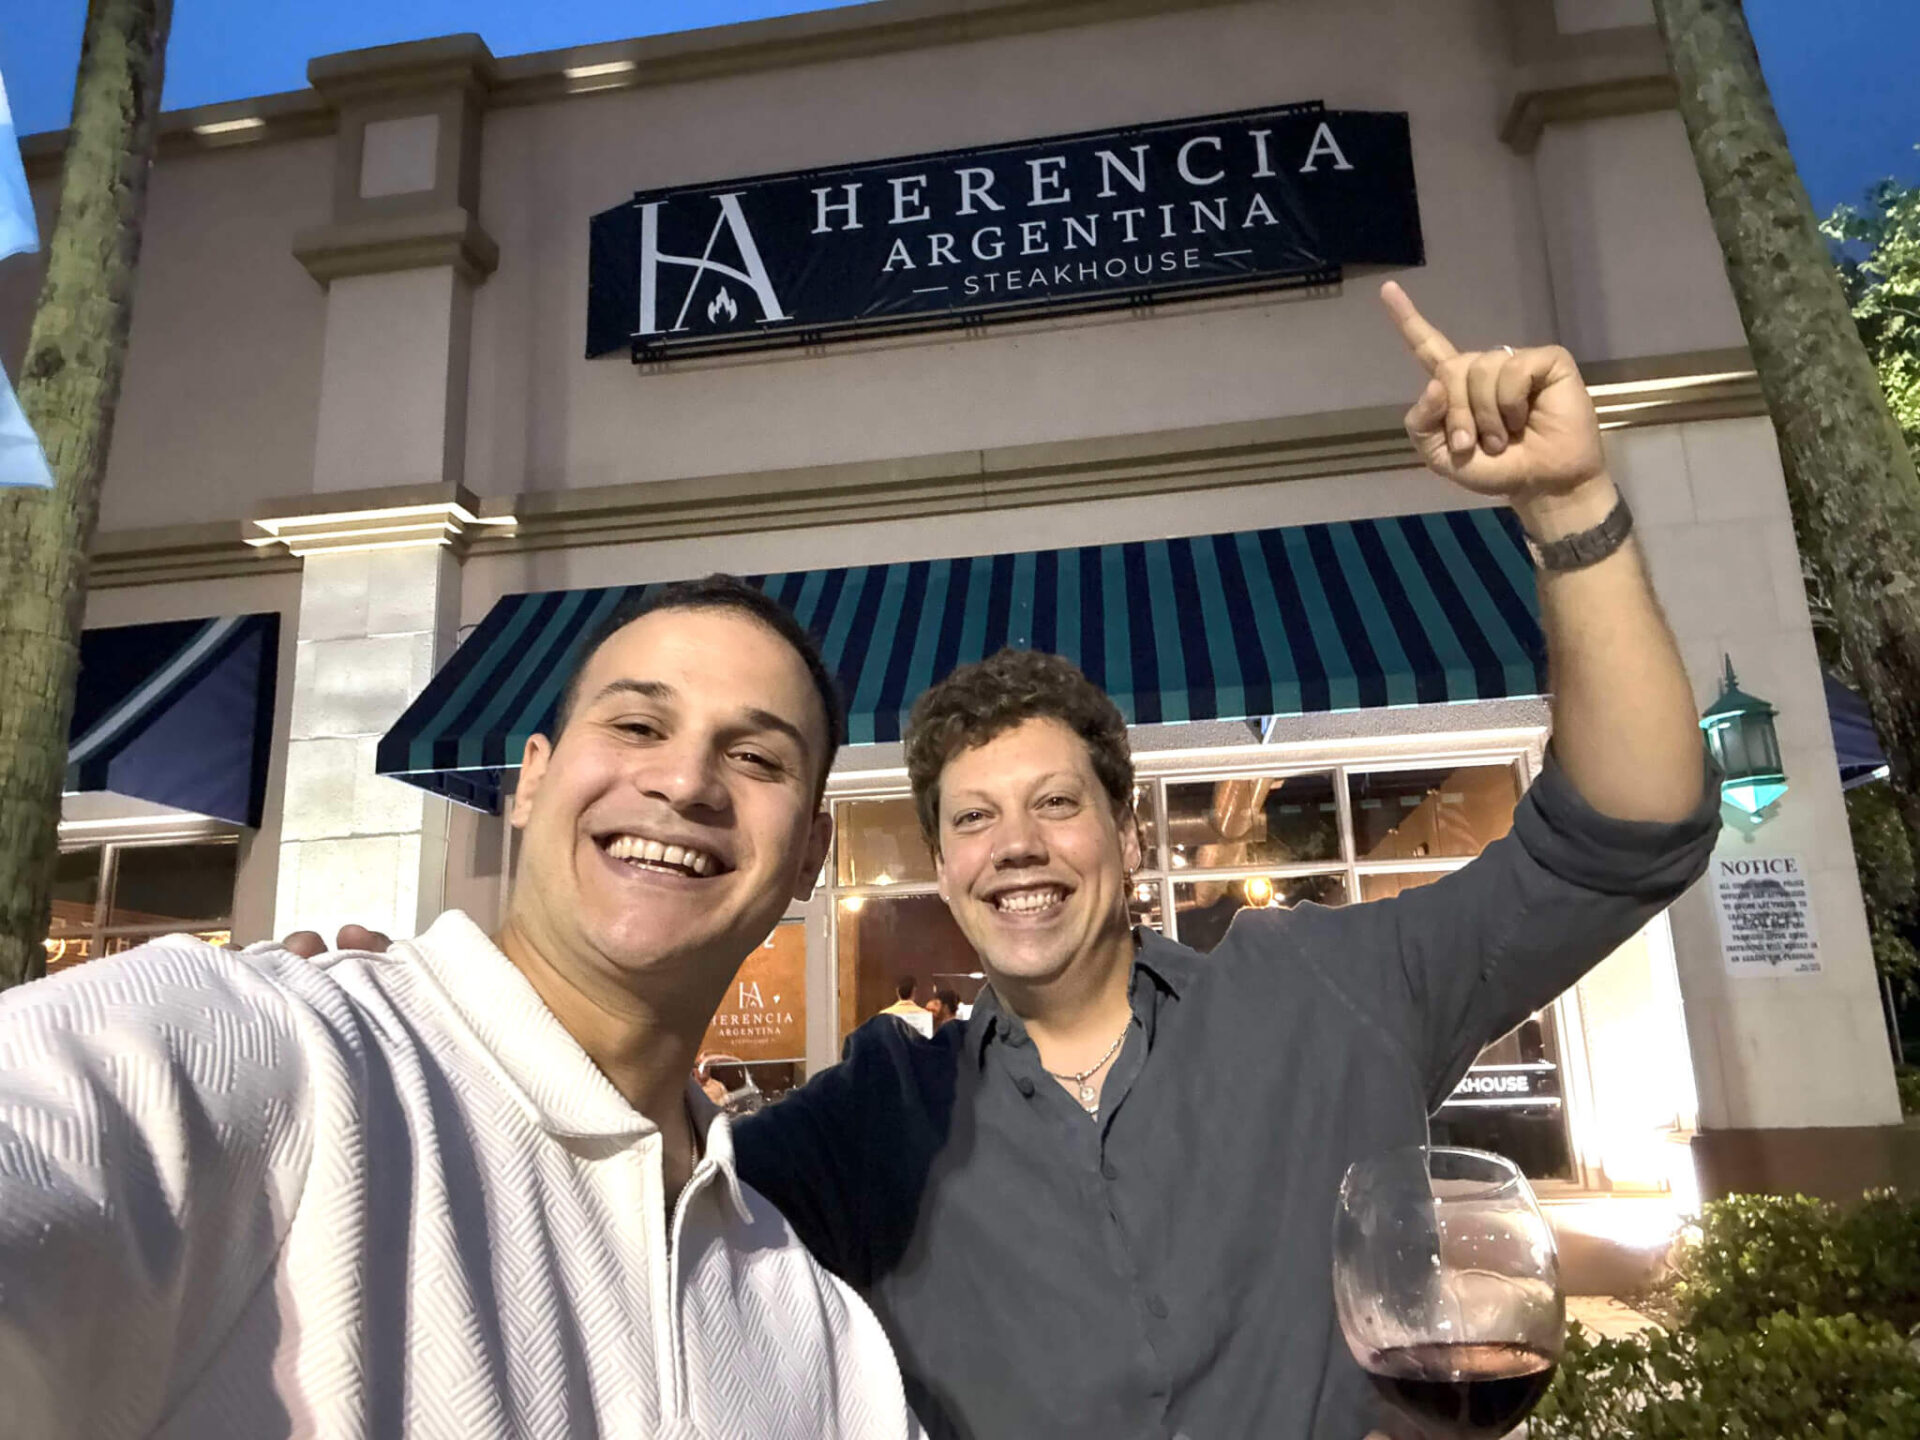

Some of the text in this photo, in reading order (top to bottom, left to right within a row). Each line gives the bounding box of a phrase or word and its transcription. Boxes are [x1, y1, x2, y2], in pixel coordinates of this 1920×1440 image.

[811, 122, 1354, 234] HERENCIA
[882, 192, 1279, 271] ARGENTINA
[964, 249, 1200, 295] STEAKHOUSE
[1720, 858, 1797, 876] NOTICE
[719, 1026, 781, 1037] ARGENTINA
